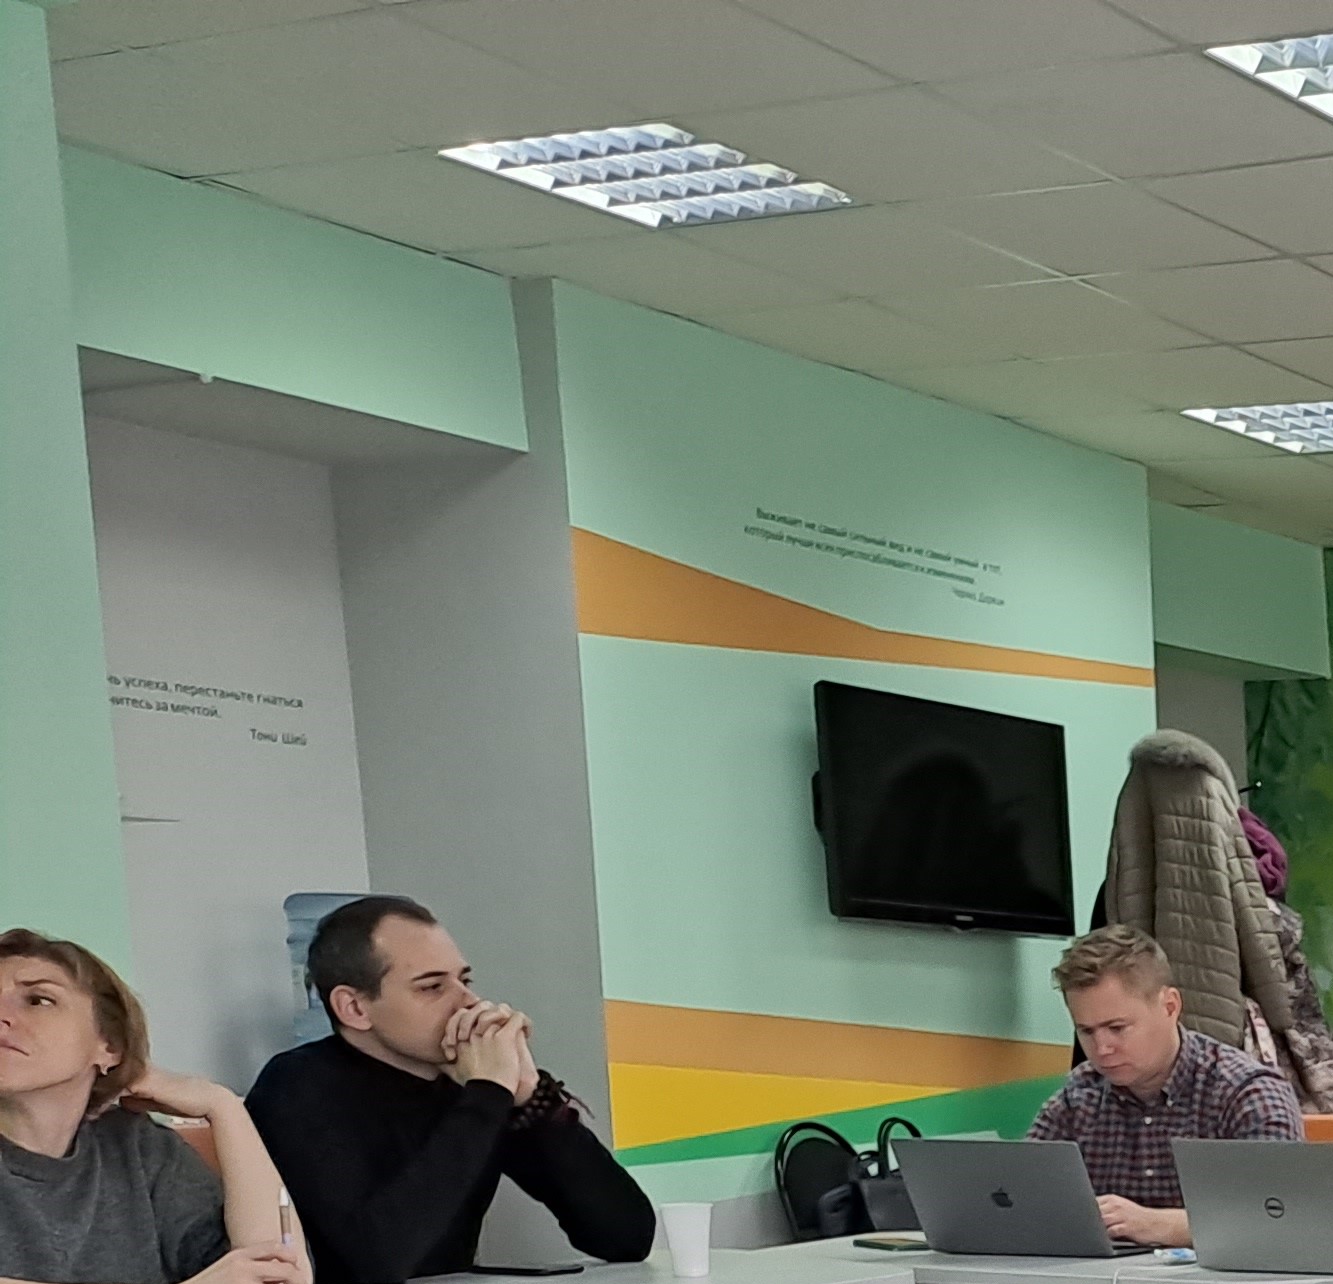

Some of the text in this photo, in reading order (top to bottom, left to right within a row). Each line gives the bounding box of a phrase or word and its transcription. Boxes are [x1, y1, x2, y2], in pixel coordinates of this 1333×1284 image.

[174, 682, 254, 704] перестаньте
[255, 693, 303, 709] гнаться
[155, 701, 169, 713] за
[249, 727, 278, 743] Тони
